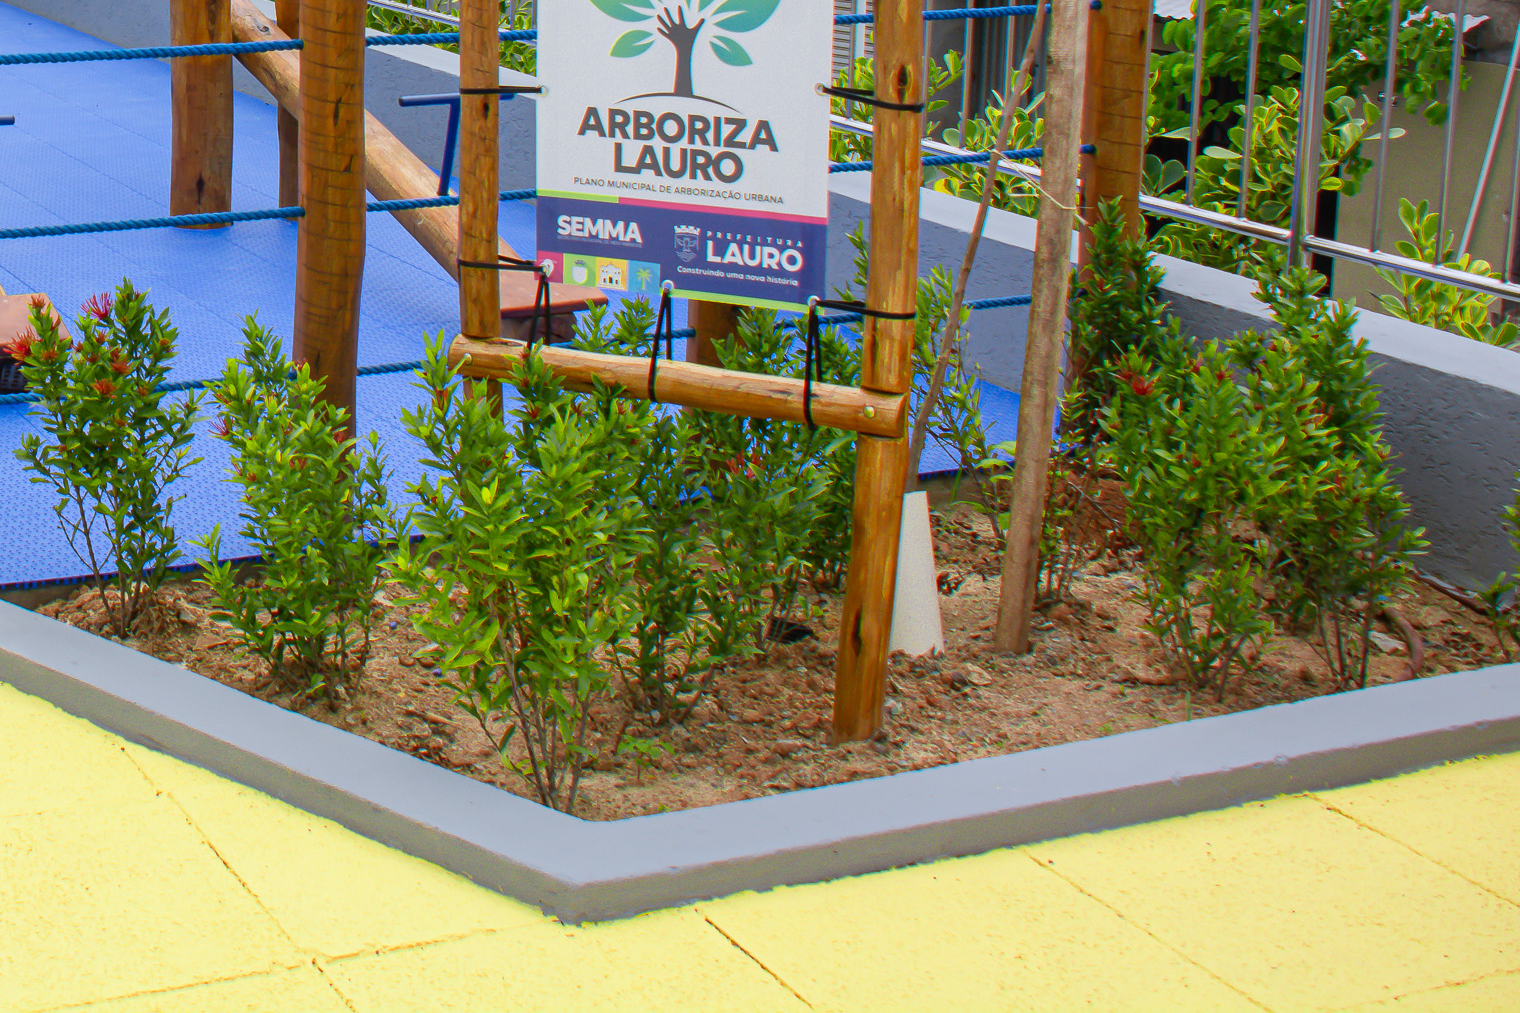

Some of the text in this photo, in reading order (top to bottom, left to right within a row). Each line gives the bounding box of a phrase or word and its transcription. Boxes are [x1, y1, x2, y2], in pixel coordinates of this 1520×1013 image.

[577, 106, 779, 152] ARBORIZA
[613, 142, 744, 183] LAURO
[573, 176, 784, 204] PLANO MUNICIPAL DE ARBORIZAÇÃO URBANA
[557, 215, 643, 244] SEMMA
[706, 230, 803, 248] PREFEITURA
[706, 239, 804, 272] LAURO
[676, 265, 798, 286] Construindo uma nova história
